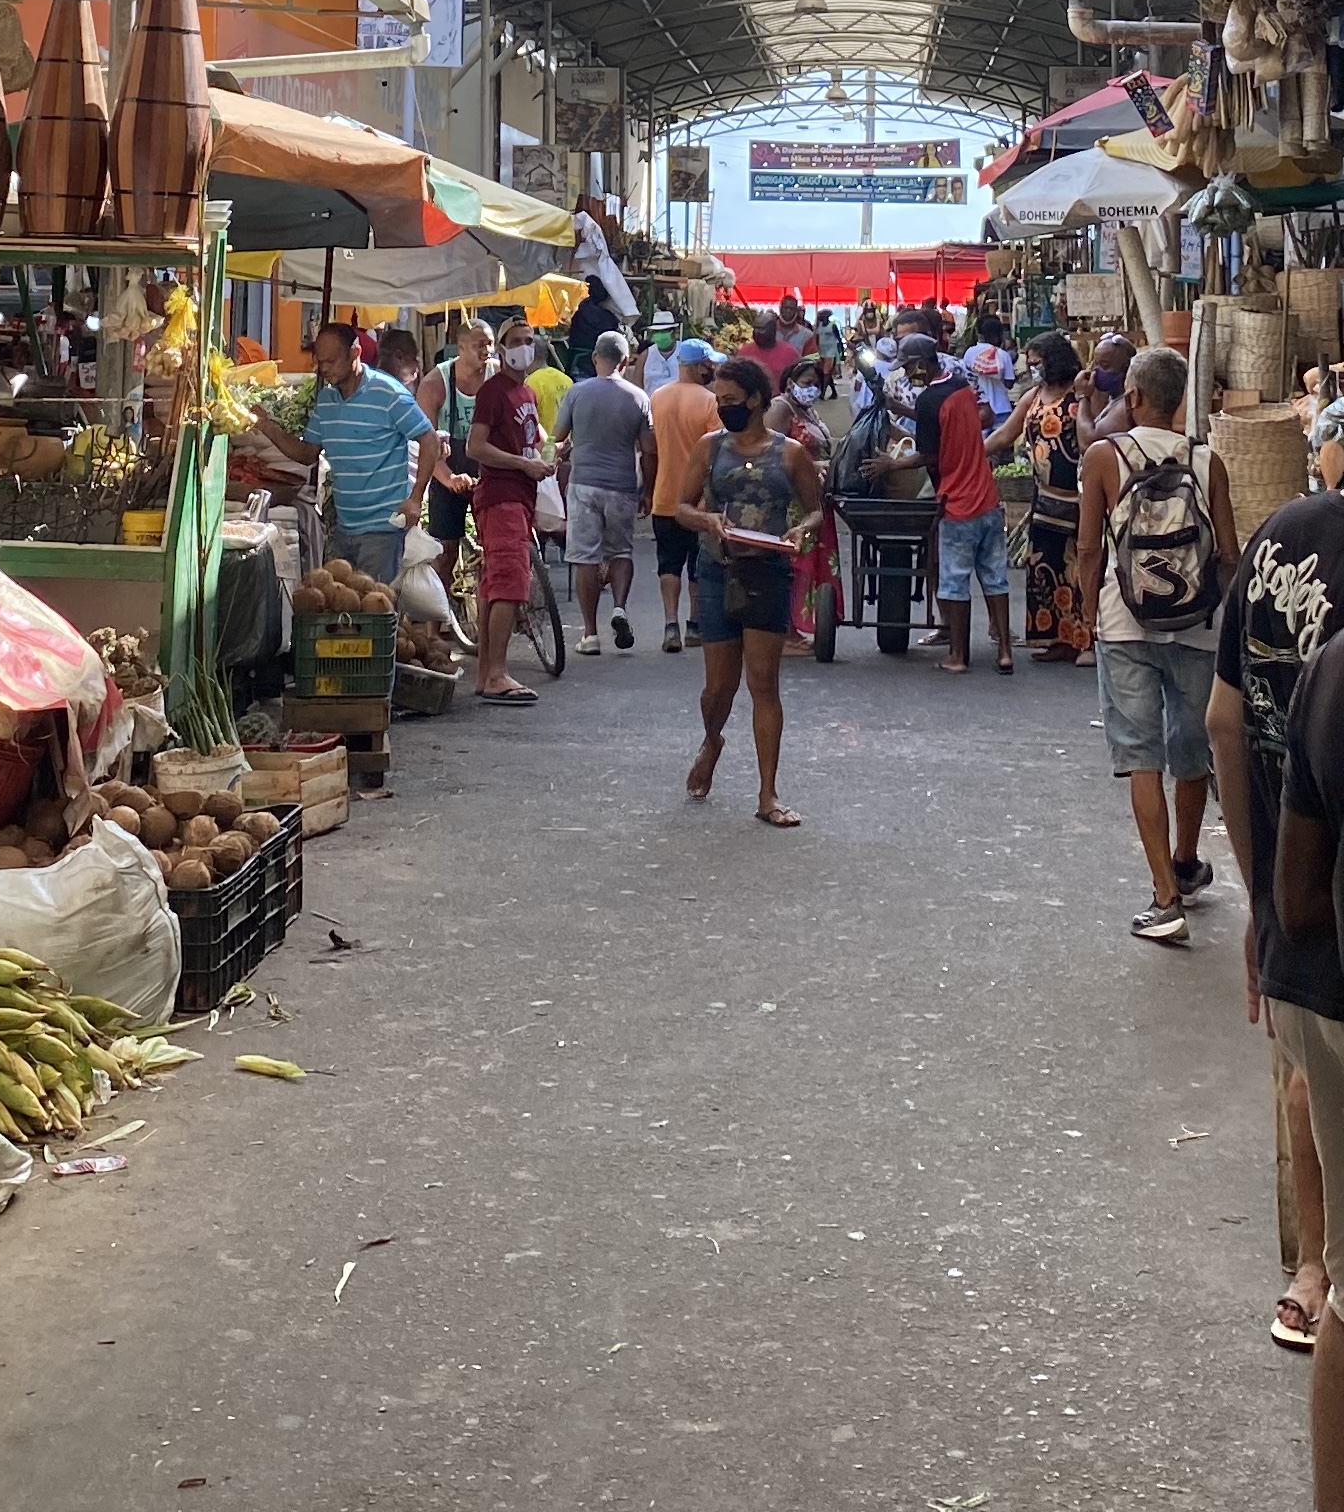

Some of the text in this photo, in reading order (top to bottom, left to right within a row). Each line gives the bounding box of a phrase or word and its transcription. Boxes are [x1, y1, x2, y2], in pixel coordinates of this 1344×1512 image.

[754, 175, 795, 186] OBRIGADO
[835, 176, 858, 187] FEIRA
[1019, 209, 1066, 222] BOHEMIA
[1098, 205, 1159, 218] BOHEMIA
